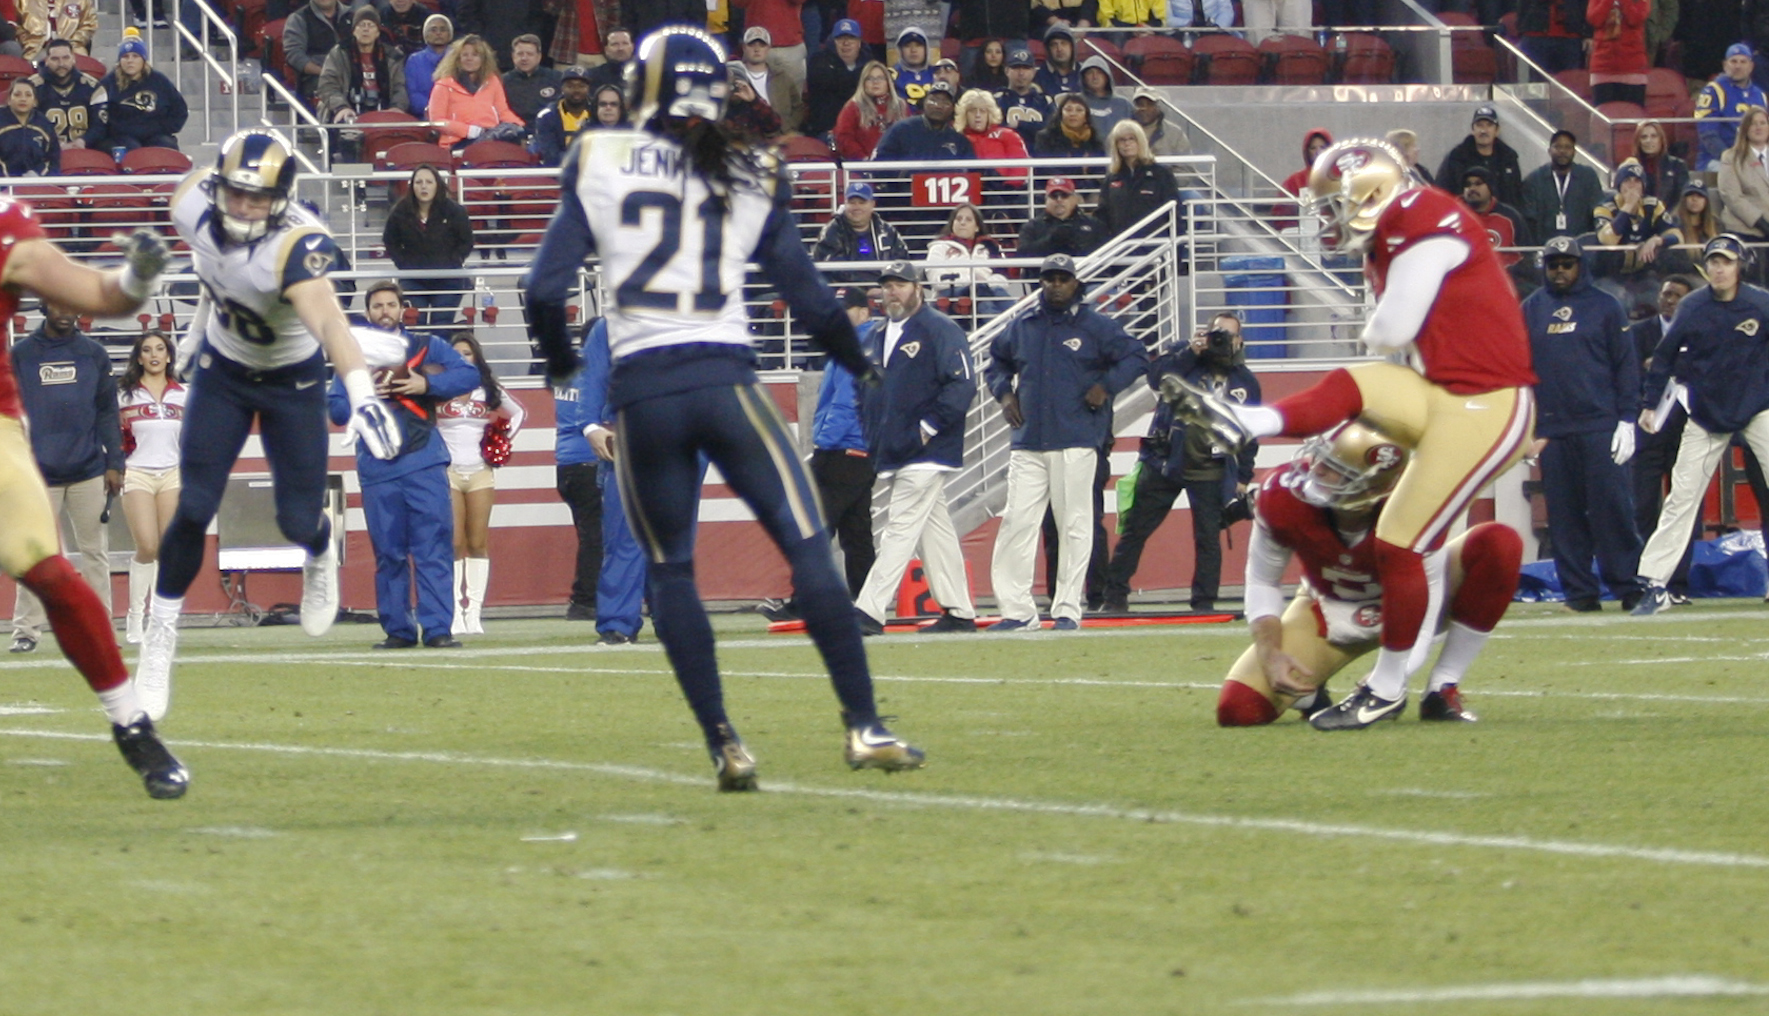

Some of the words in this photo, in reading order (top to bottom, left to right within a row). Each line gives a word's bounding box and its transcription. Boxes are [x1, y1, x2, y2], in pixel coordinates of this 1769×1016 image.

[924, 177, 969, 204] 112
[616, 191, 730, 312] 21
[1322, 566, 1382, 602] 5
